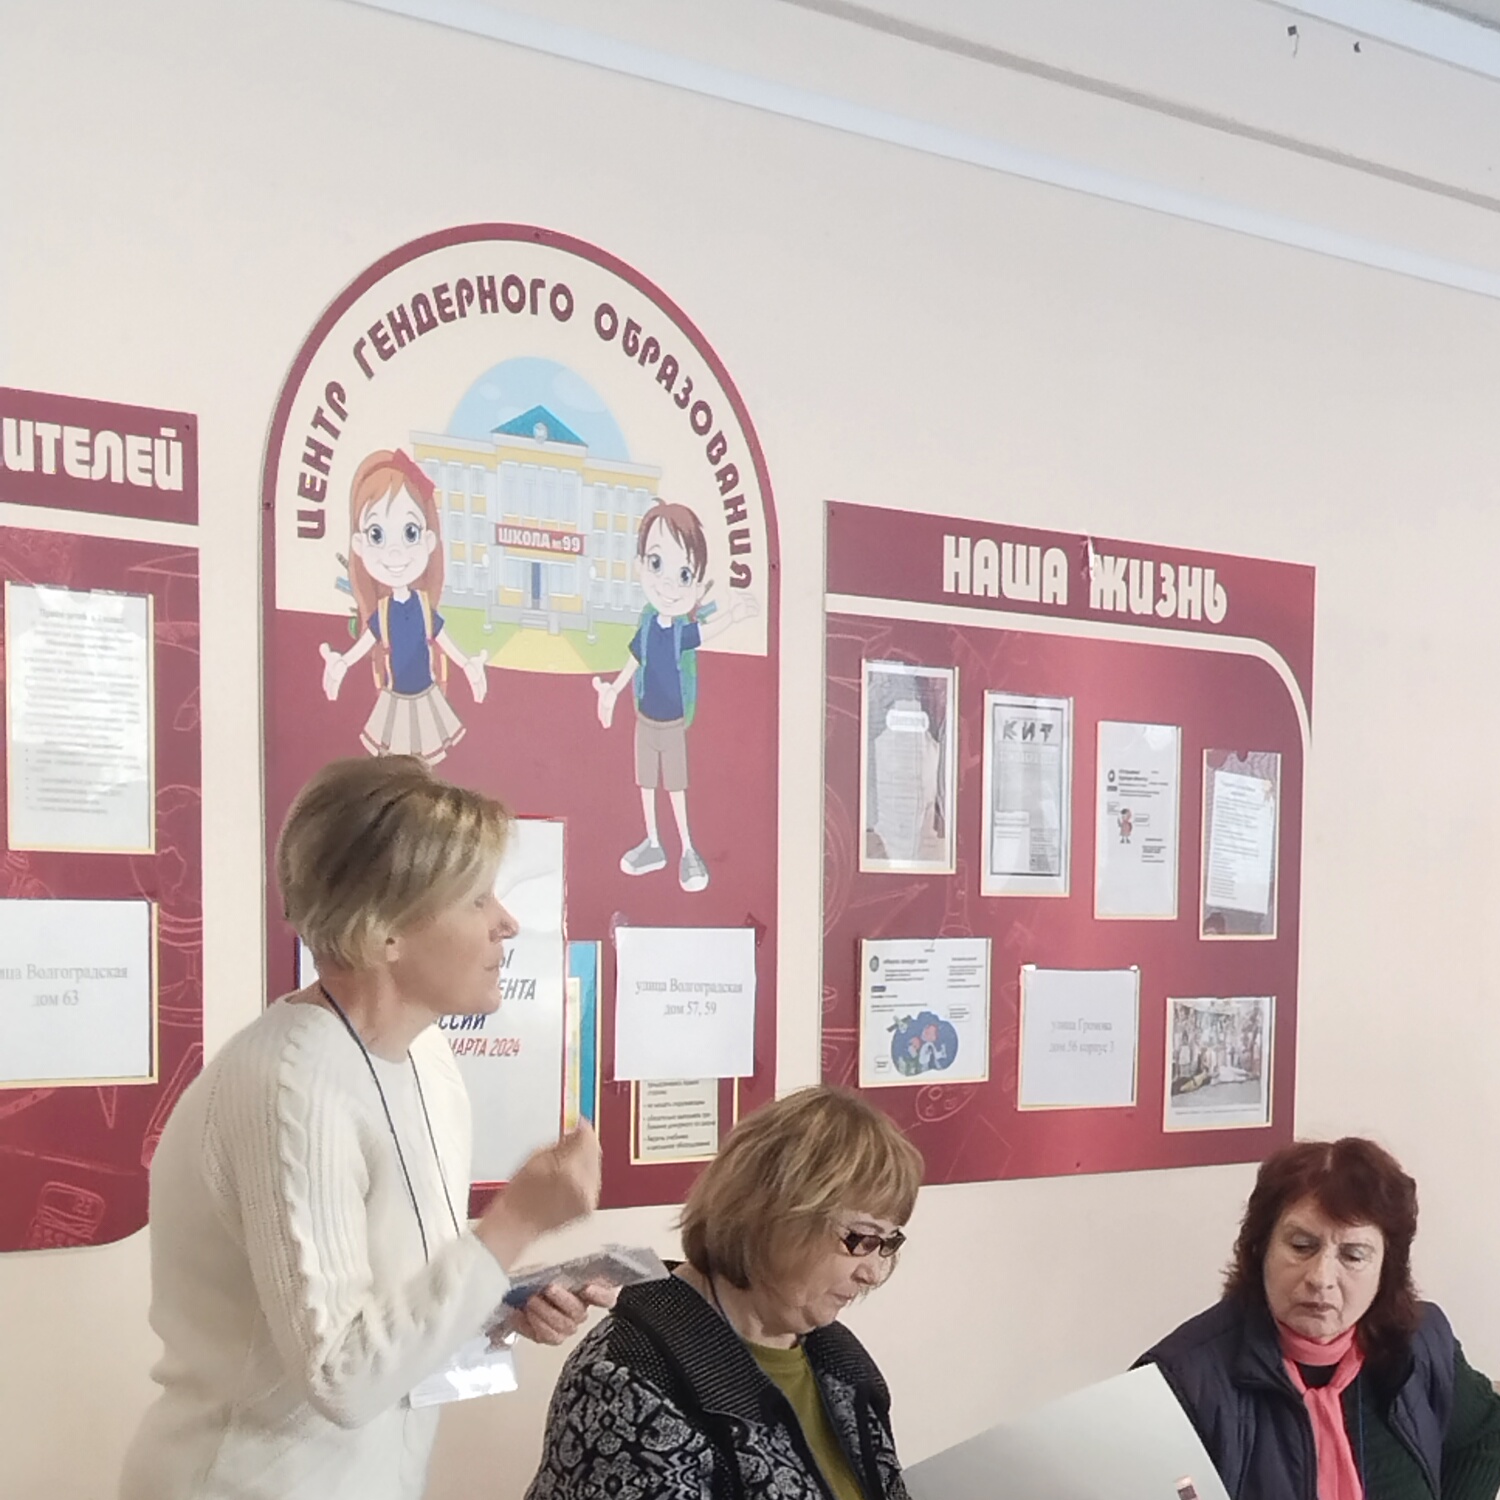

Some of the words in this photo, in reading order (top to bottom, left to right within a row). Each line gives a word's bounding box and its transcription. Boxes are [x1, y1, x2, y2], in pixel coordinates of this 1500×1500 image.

[297, 381, 348, 539] ЦЕНТР
[353, 274, 574, 379] ГЕНДЕРНОГО
[594, 303, 752, 589] ОБРАЗОВАНИЯ
[498, 527, 551, 549] ШКОЛА
[943, 535, 1068, 605] НАША
[1088, 553, 1228, 624] ЖИЗНЬ
[26, 963, 128, 983] Волгоградская
[62, 989, 79, 1007] 63
[704, 1001, 717, 1016] 59
[489, 1037, 521, 1057] 2024
